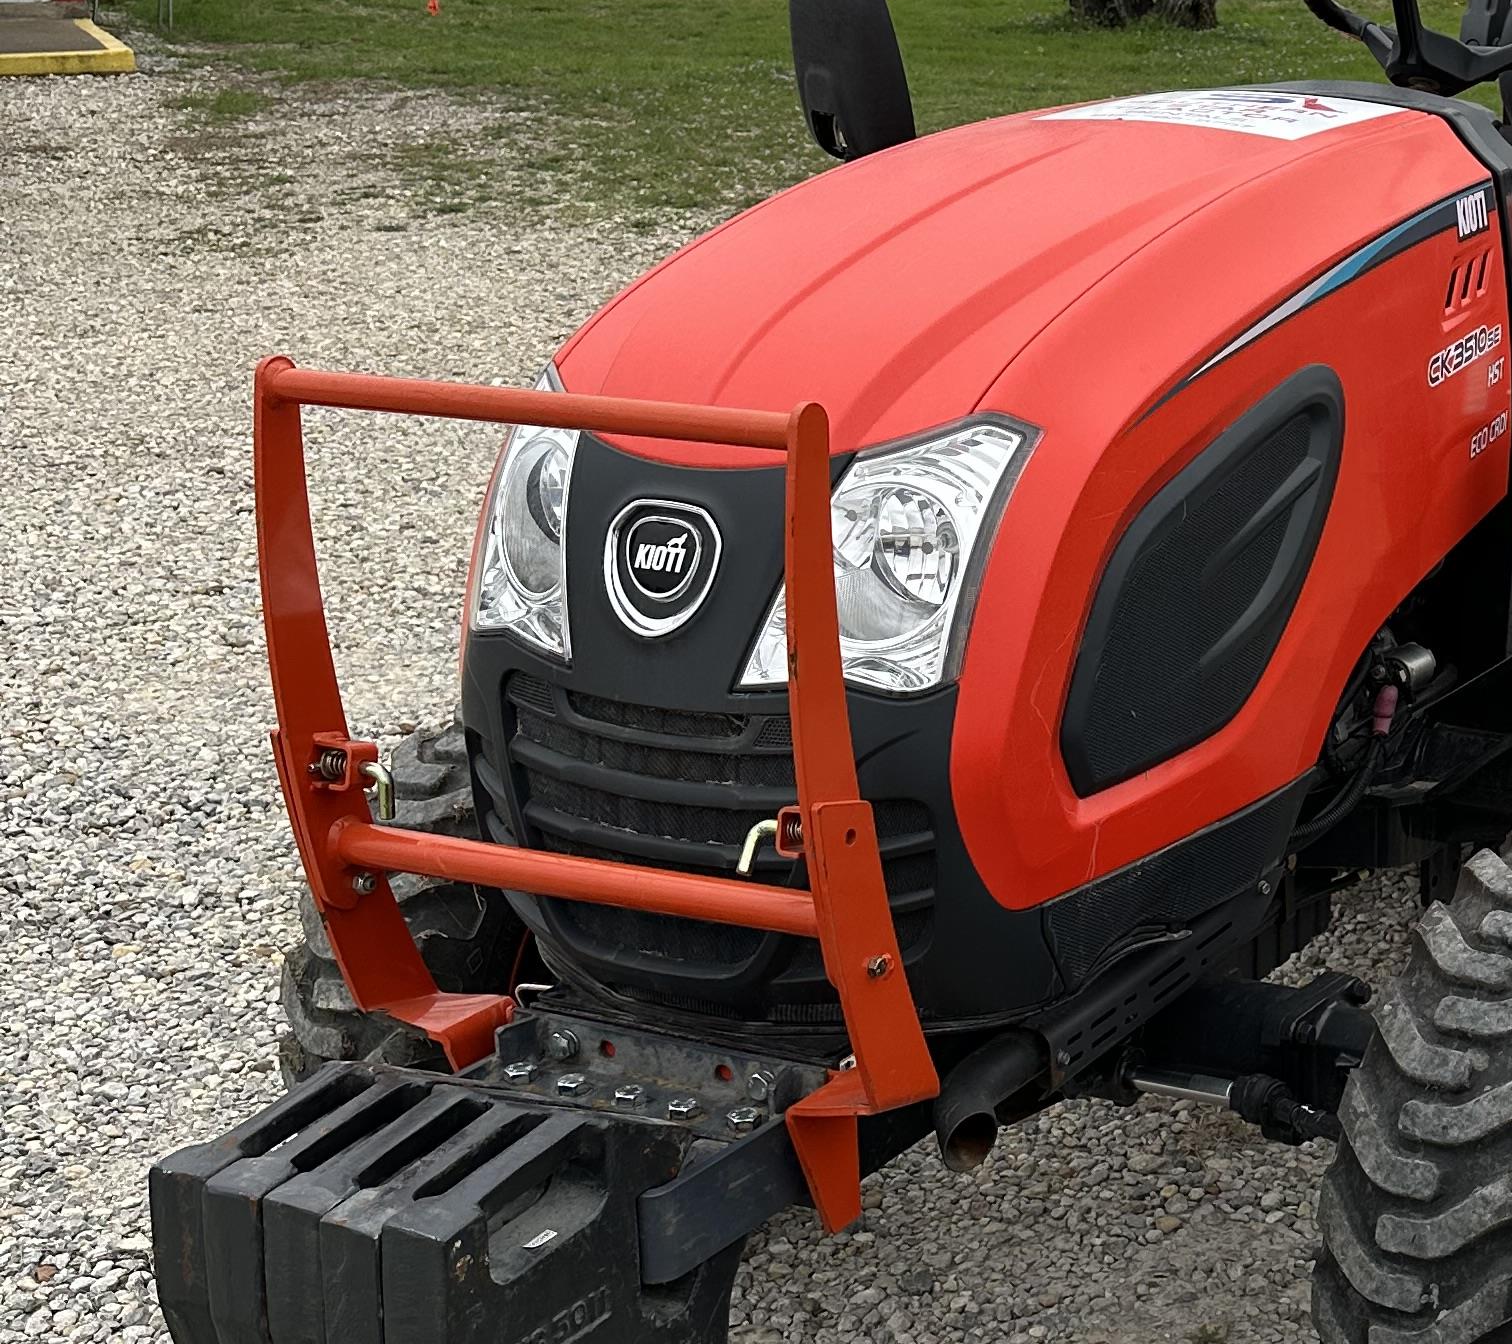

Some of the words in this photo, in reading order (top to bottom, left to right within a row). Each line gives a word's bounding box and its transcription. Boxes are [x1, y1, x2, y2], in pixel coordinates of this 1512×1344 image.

[1456, 190, 1488, 237] KIOTI
[1428, 324, 1501, 387] CK3510SE
[1487, 356, 1504, 388] HST
[1470, 427, 1489, 459] ECO
[1489, 409, 1509, 443] CRDI
[634, 543, 687, 574] KIOTI
